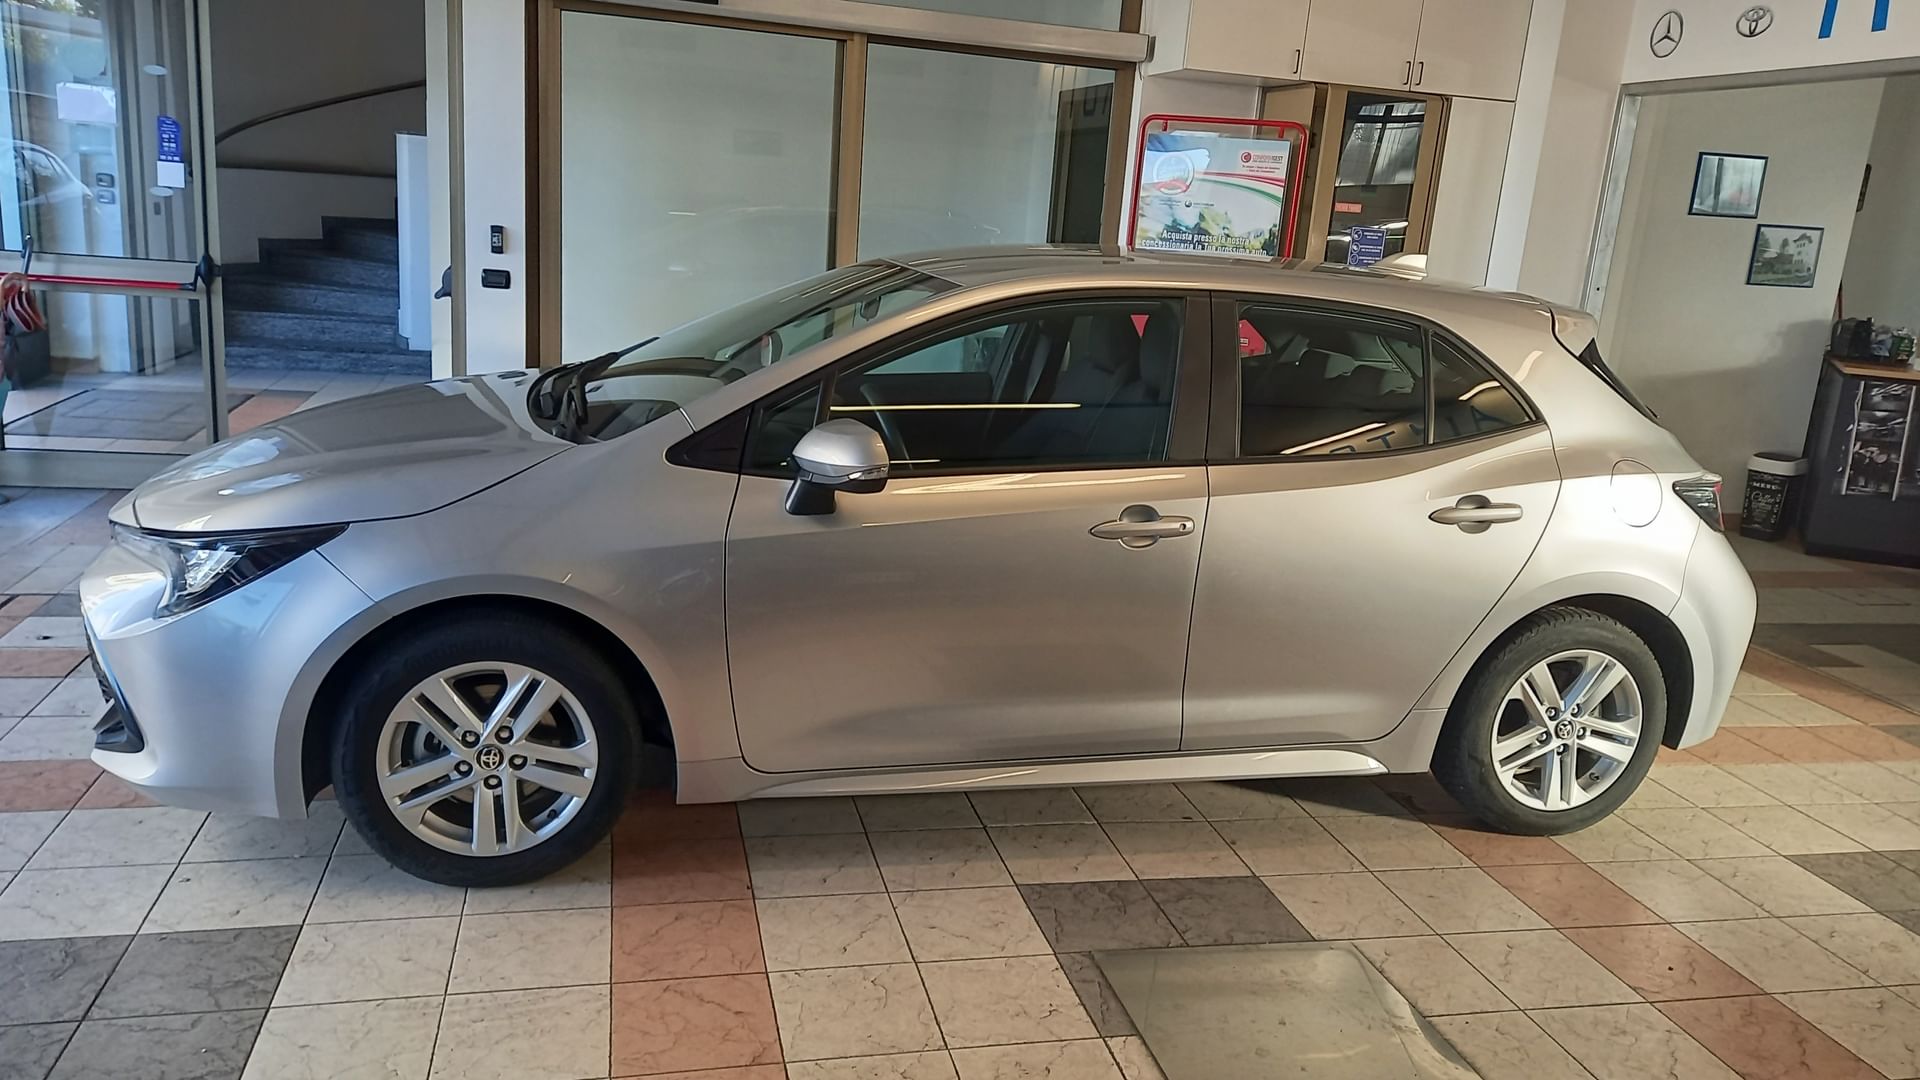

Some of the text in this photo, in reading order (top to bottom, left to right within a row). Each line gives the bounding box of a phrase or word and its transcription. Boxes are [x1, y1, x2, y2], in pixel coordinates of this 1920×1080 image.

[1162, 229, 1250, 245] Acquista presso la nostra
[1142, 240, 1194, 250] concessionaria
[1195, 242, 1202, 250] la
[1203, 243, 1216, 252] Tua
